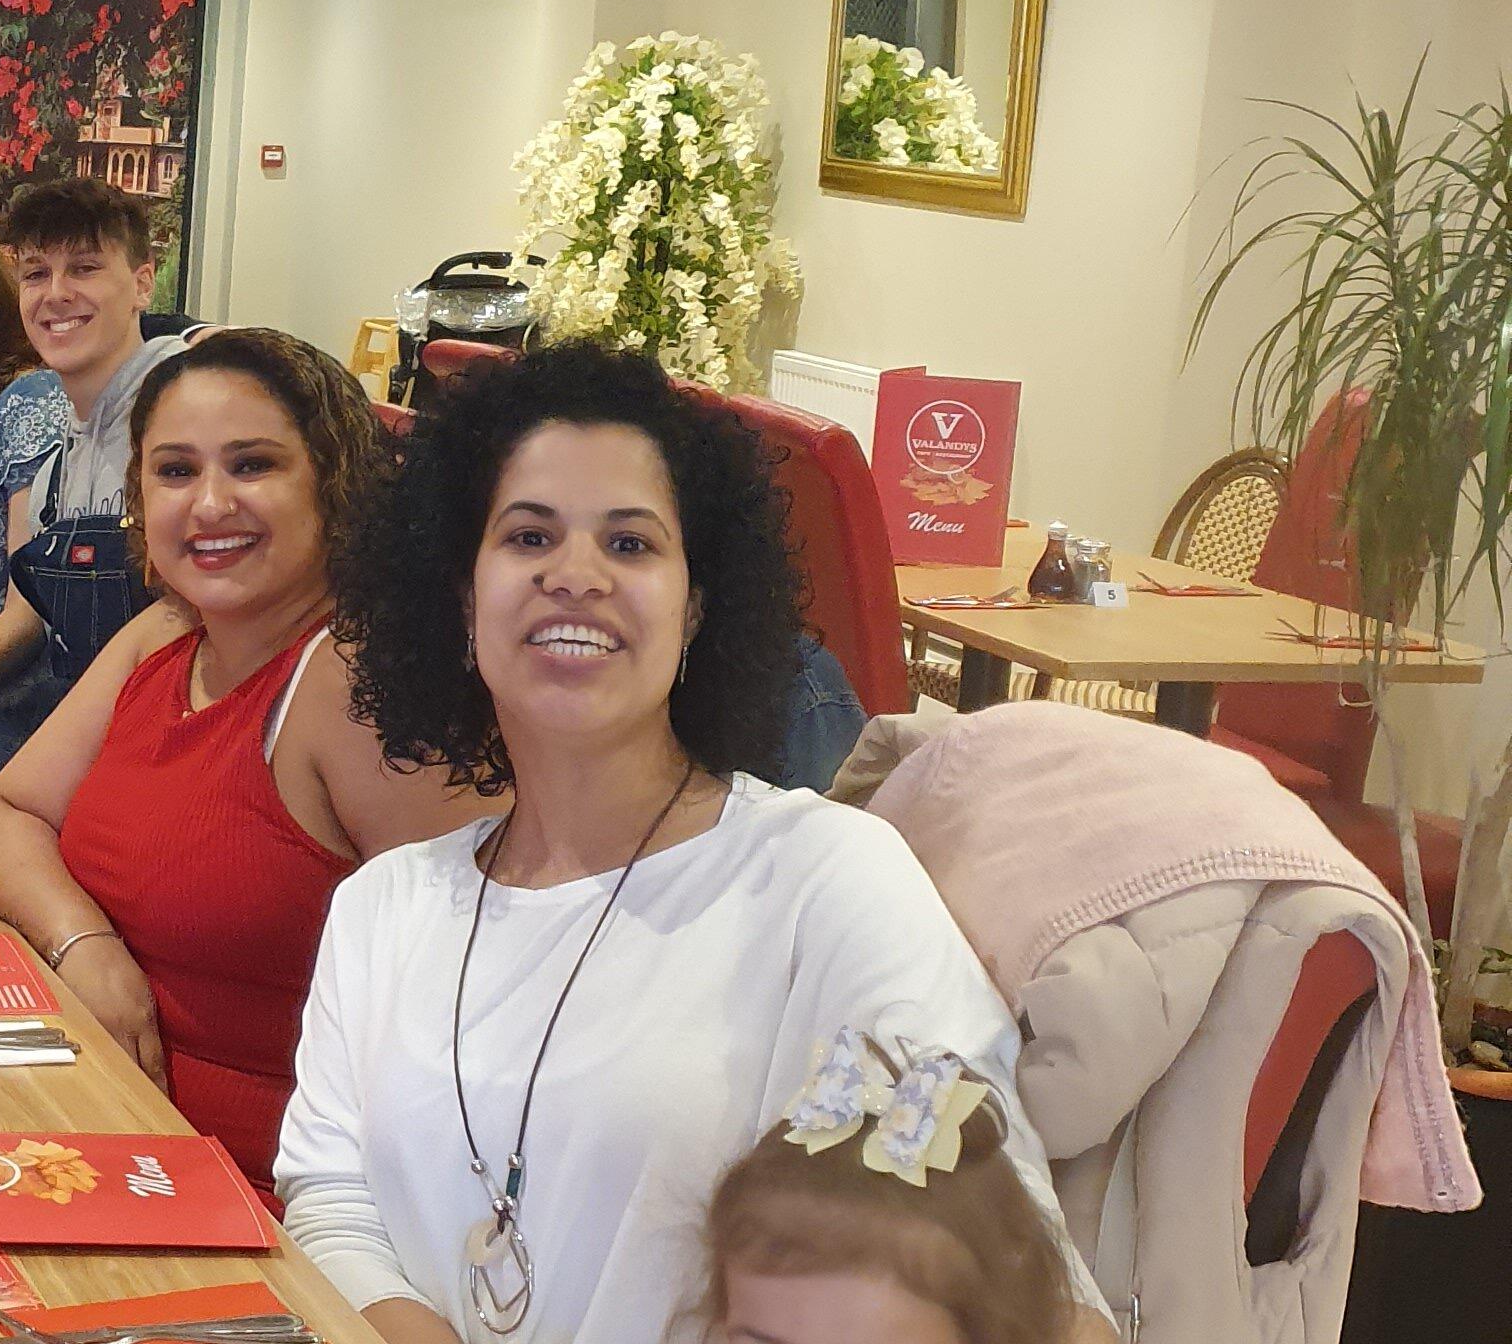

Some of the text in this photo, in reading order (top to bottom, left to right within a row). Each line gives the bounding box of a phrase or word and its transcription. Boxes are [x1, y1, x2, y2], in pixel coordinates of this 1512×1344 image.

[931, 411, 964, 439] V
[911, 438, 978, 454] VALANDYS
[907, 510, 965, 534] Menu
[1107, 589, 1117, 601] 5
[123, 1154, 178, 1197] Menu
